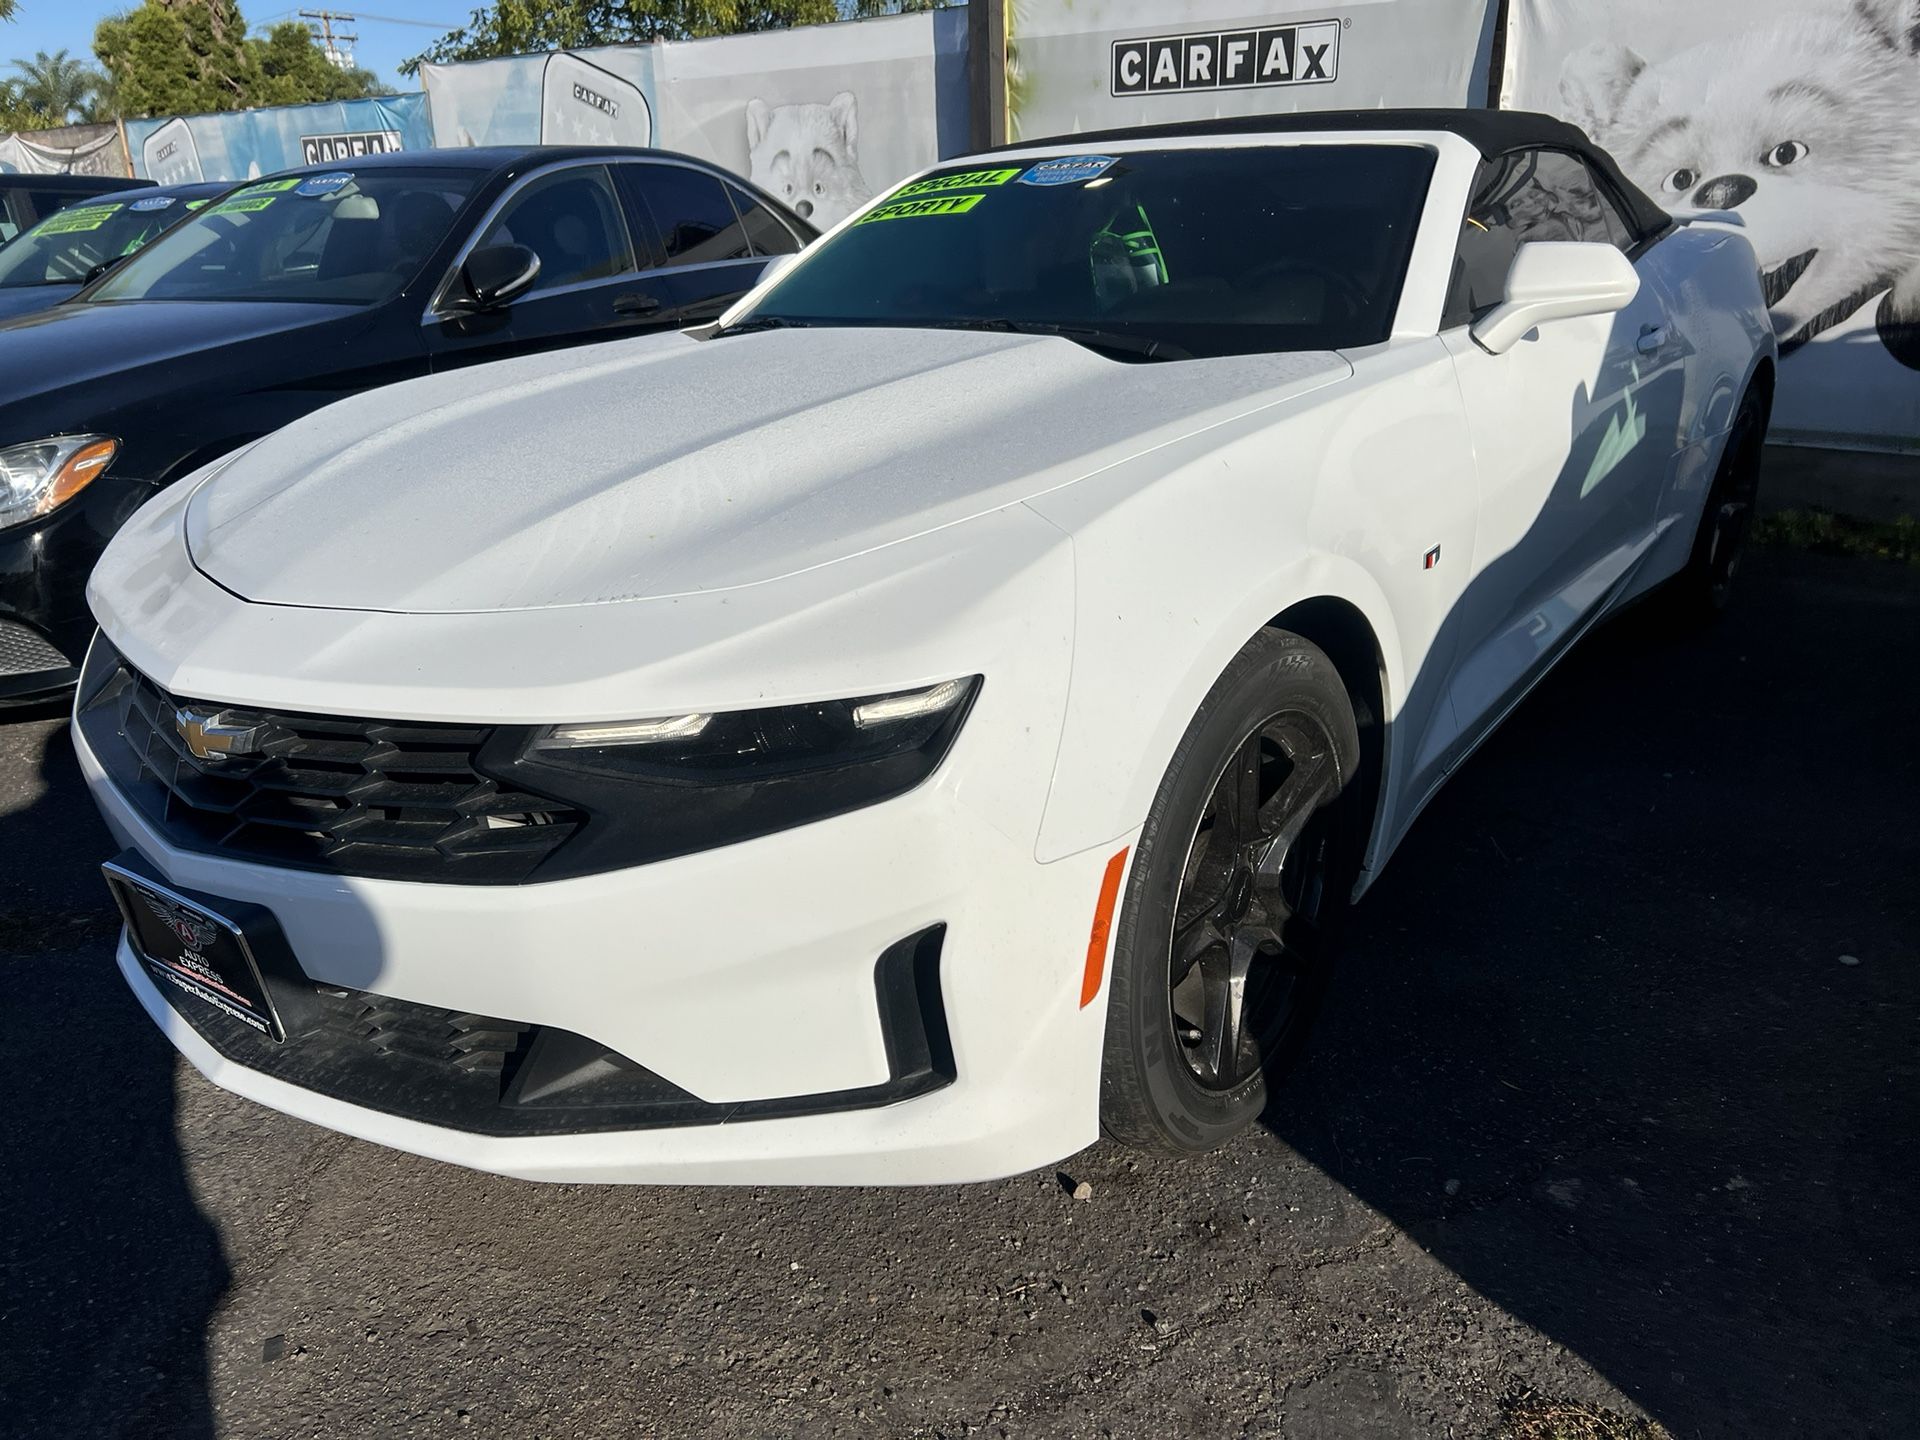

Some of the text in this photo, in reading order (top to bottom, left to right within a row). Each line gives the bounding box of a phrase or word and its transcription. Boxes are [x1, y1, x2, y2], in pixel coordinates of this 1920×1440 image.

[1117, 34, 1334, 89] CARFAX
[573, 84, 619, 119] CARFAX
[304, 138, 402, 166] CARFA
[900, 170, 1006, 196] SPECIAL
[862, 197, 974, 222] SPORTY
[178, 955, 224, 984] EXPRESS
[184, 948, 210, 968] AUTO
